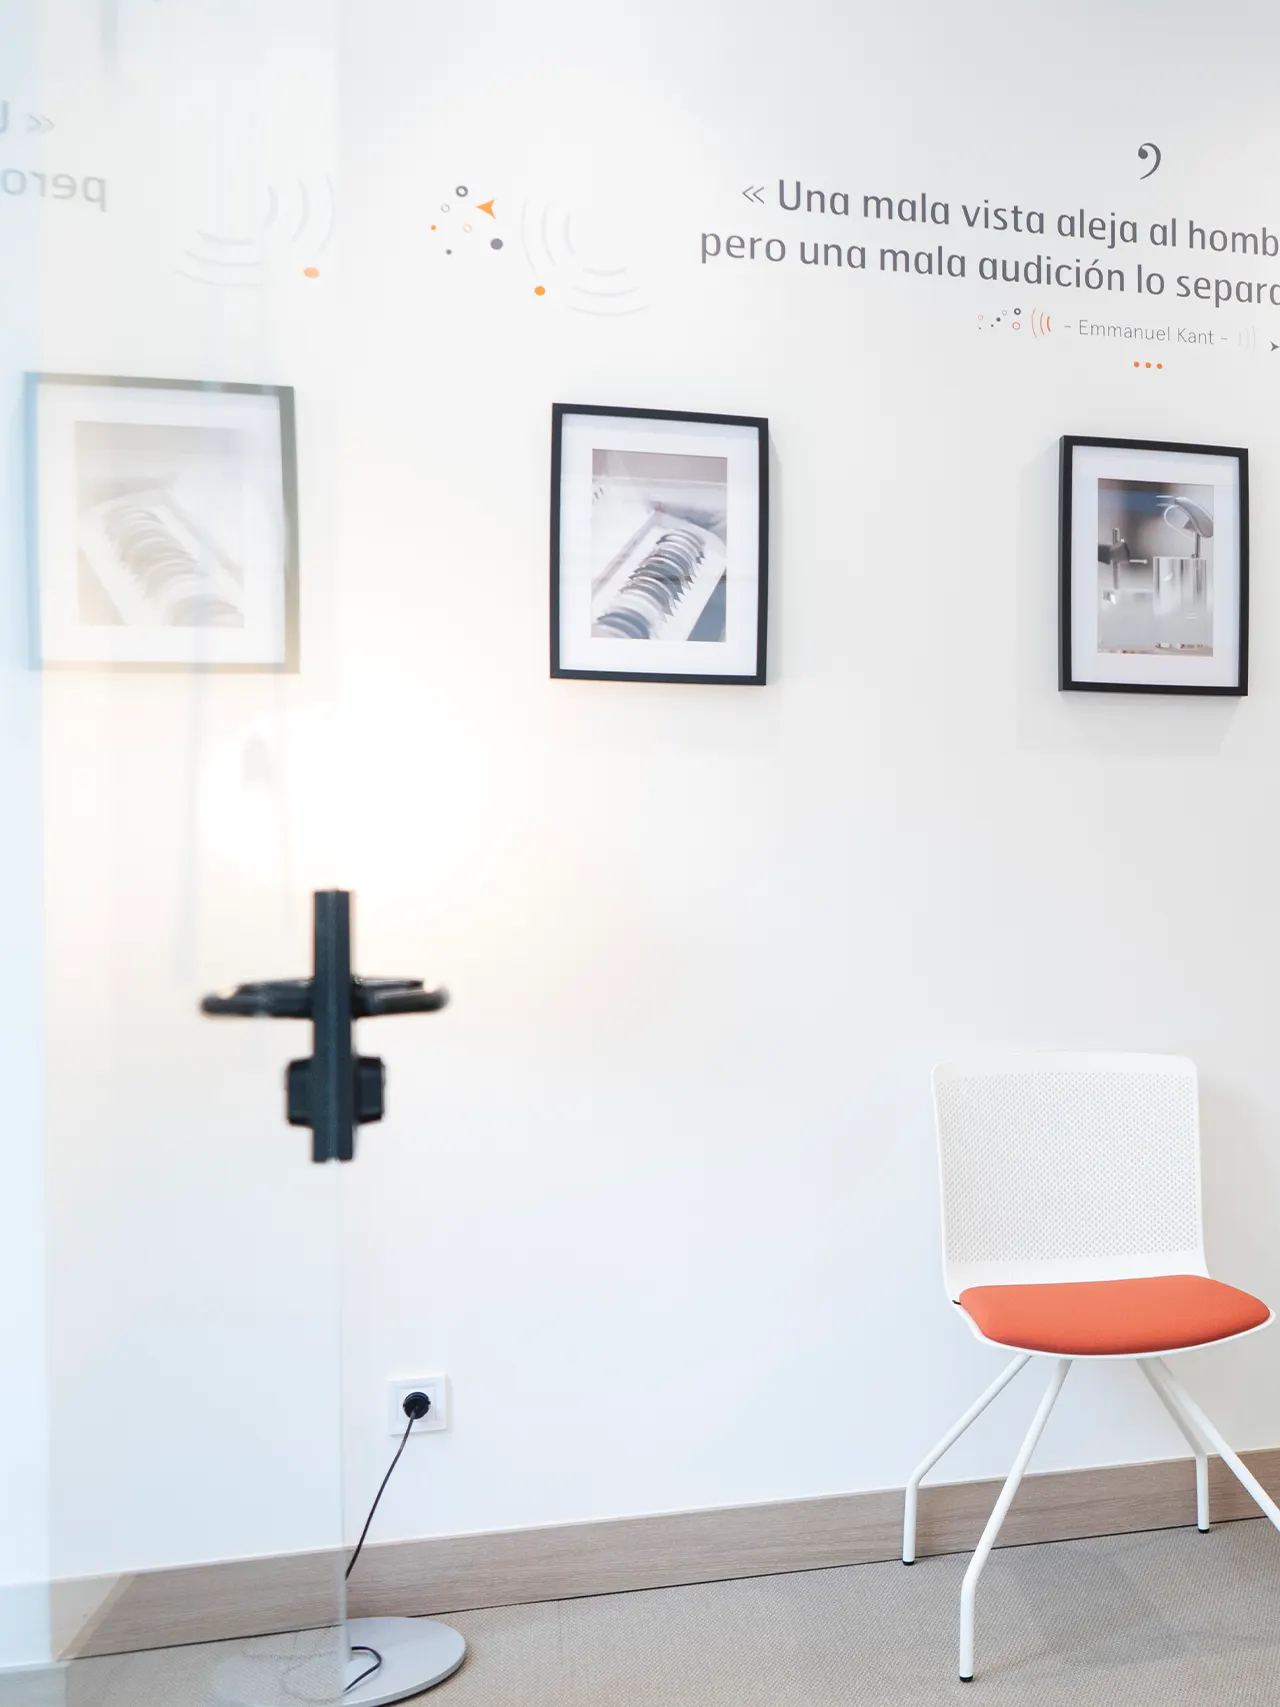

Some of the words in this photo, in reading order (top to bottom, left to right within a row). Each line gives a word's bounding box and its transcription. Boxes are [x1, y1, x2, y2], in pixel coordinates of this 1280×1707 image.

[778, 178, 850, 217] Una
[863, 192, 950, 226] mala
[961, 199, 1045, 235] vista
[1056, 208, 1138, 250] aleja
[1149, 217, 1177, 248] al
[701, 232, 786, 265] pero
[799, 241, 866, 270] una
[879, 245, 966, 278] mala
[978, 254, 1125, 293] audición
[1137, 263, 1165, 296] lo
[1078, 318, 1171, 343] Emmanuel
[1177, 327, 1214, 345] Kant
